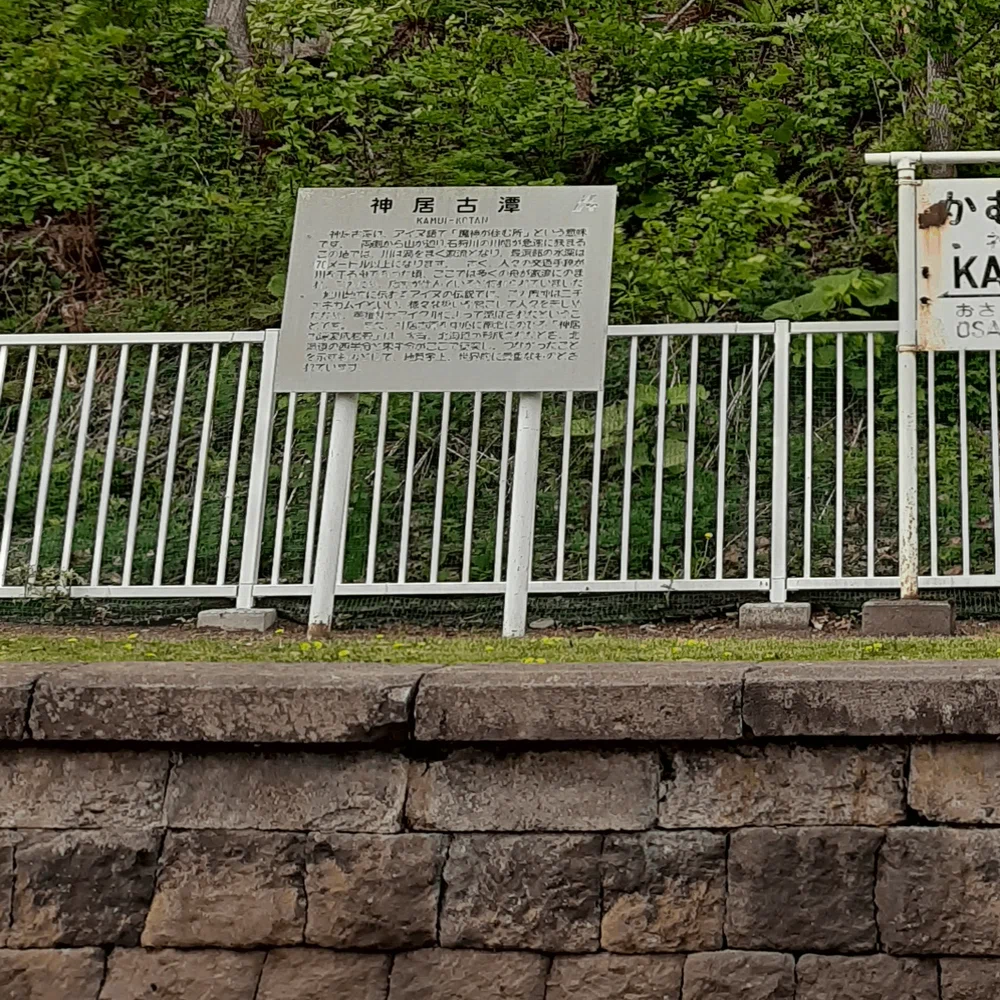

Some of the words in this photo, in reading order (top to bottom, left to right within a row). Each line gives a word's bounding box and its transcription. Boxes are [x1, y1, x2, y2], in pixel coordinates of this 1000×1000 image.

[370, 196, 521, 214] 神居古潭
[416, 216, 489, 225] KAMUI-KOTAN
